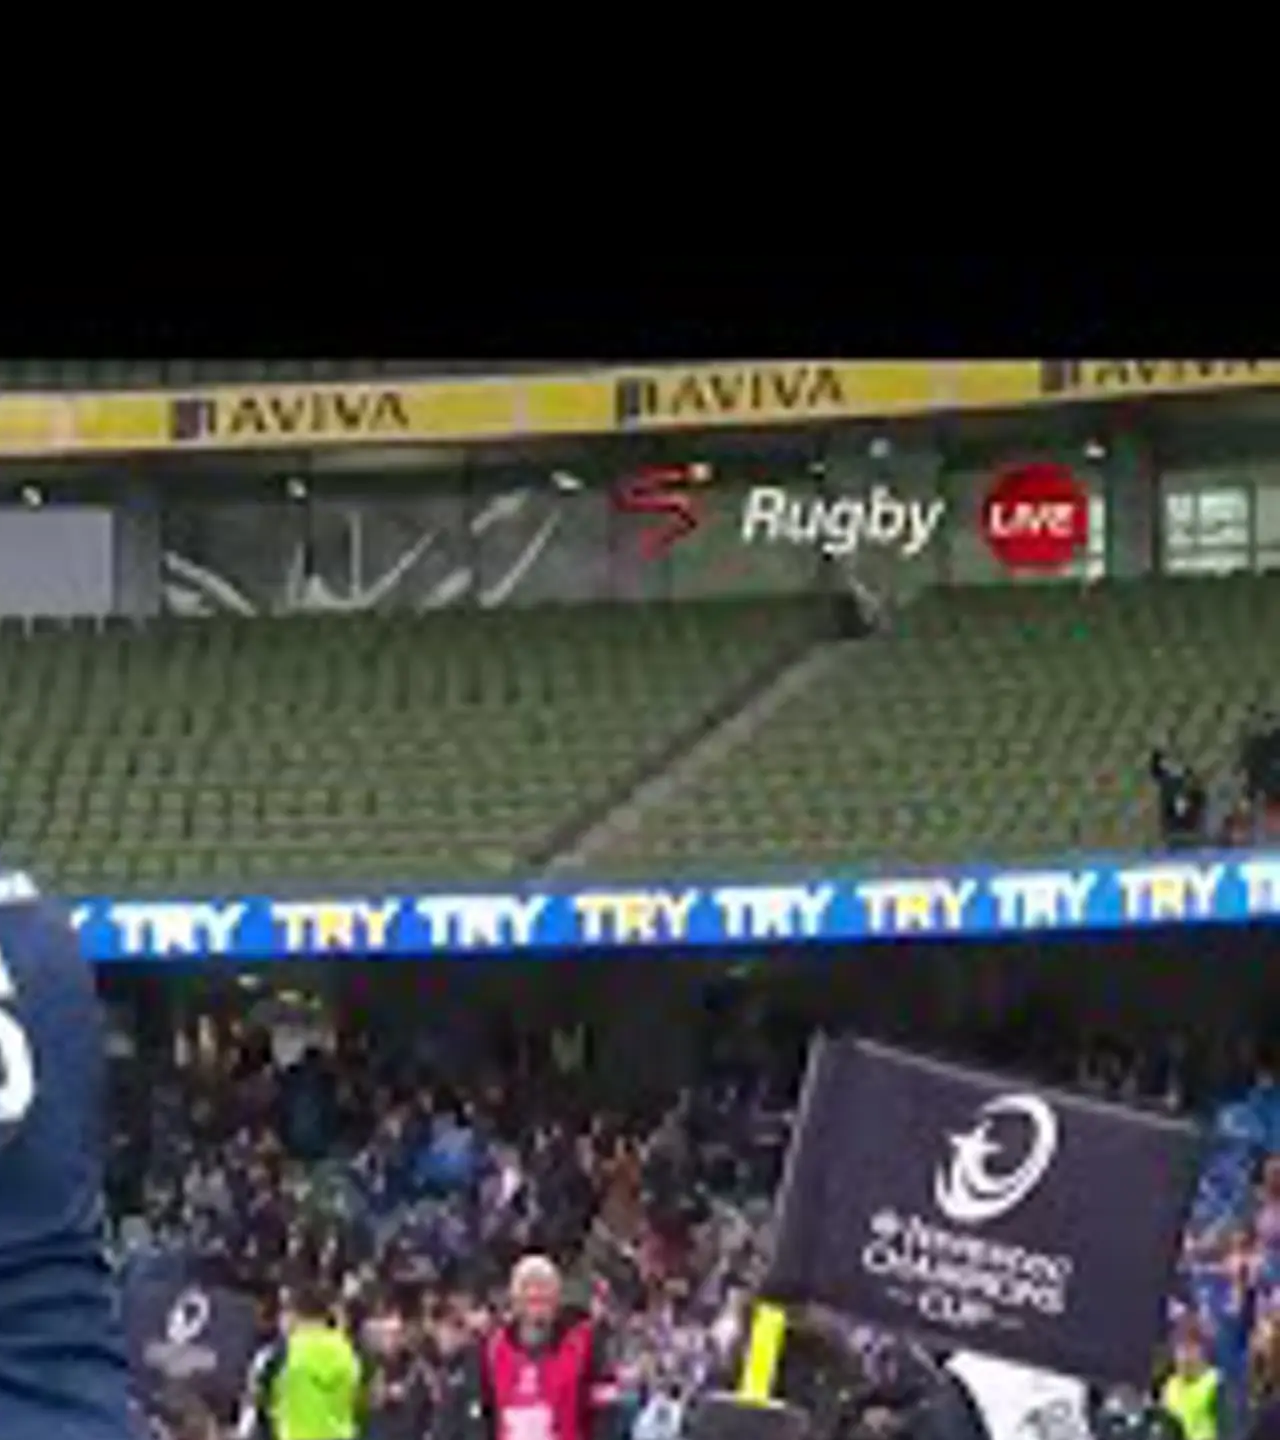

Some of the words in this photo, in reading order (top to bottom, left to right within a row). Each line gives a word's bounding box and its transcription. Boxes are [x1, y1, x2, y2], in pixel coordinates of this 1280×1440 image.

[228, 391, 412, 434] AVIVA
[670, 368, 847, 414] AVIVA
[573, 890, 698, 942] TRY
[712, 886, 834, 937] TRY
[856, 880, 976, 932] TRY
[989, 872, 1097, 928] TRY
[1115, 863, 1224, 920] TRY
[107, 901, 246, 952] TRY
[273, 899, 400, 952] TRY
[414, 896, 546, 946] TRY
